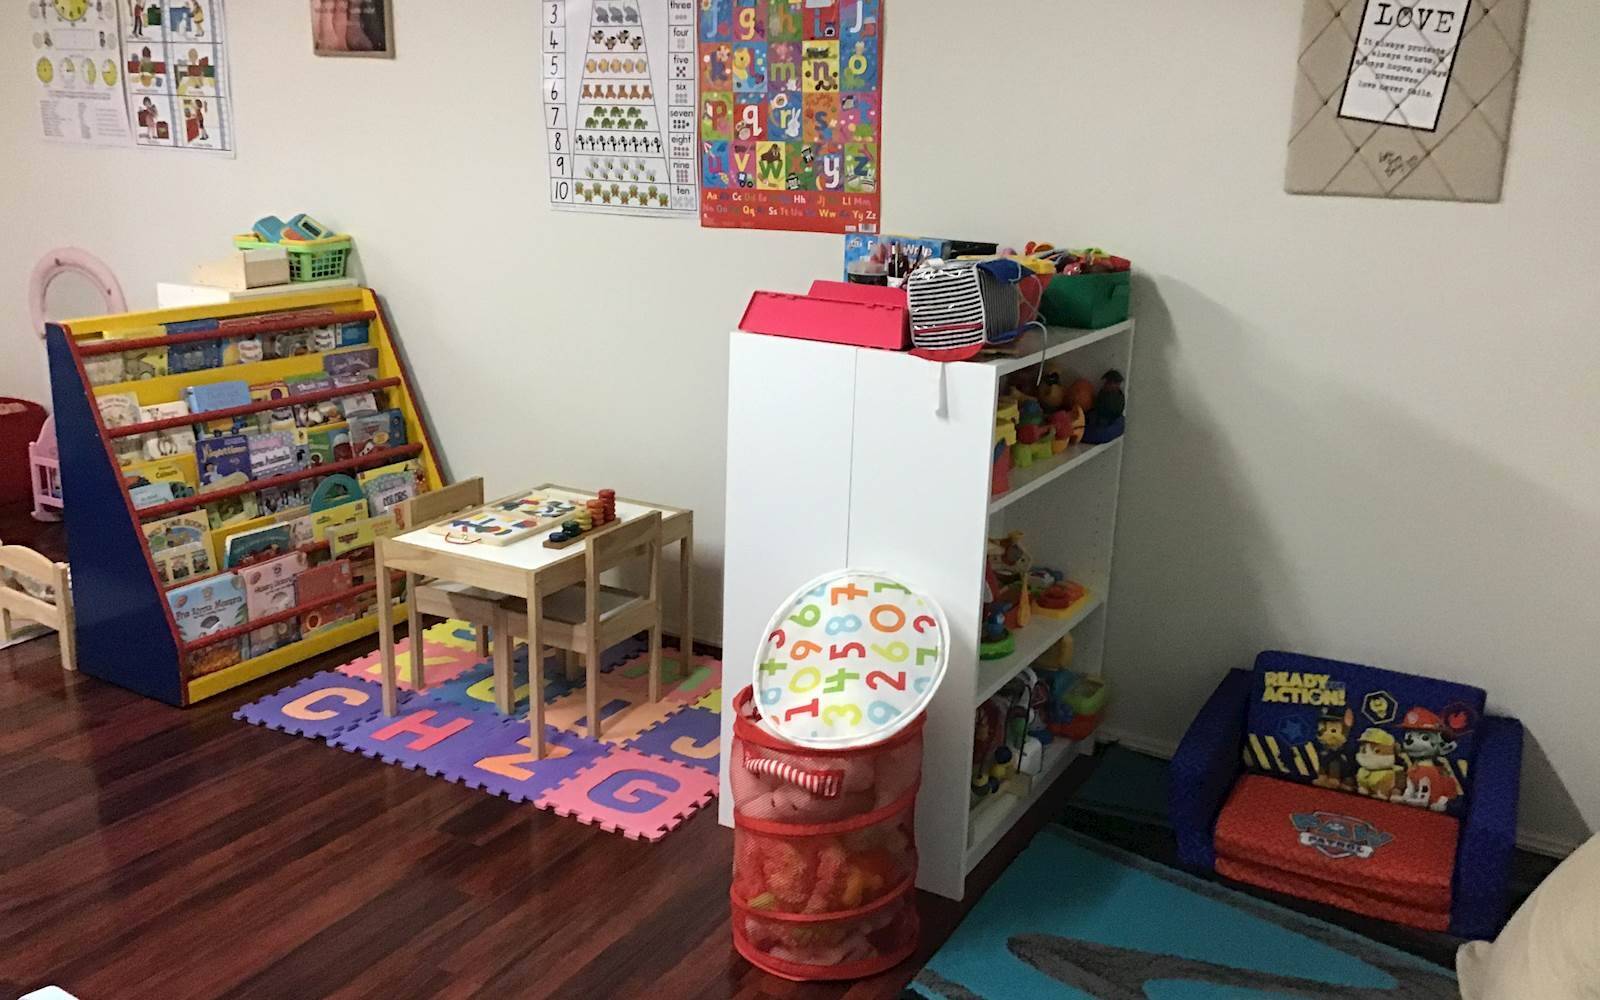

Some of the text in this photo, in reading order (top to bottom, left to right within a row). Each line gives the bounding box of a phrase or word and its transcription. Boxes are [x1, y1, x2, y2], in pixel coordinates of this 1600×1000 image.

[550, 4, 557, 24] 3
[670, 1, 692, 9] three
[739, 7, 755, 40] g
[1373, 3, 1455, 33] LOVE
[550, 30, 558, 49] 4
[673, 28, 689, 37] four
[550, 55, 558, 75] 5
[673, 56, 689, 64] five
[848, 54, 868, 75] o
[770, 62, 796, 82] m
[551, 82, 558, 100] 6
[551, 107, 559, 126] 7
[670, 110, 694, 118] seven
[742, 104, 762, 137] q
[779, 109, 792, 129] r
[555, 132, 561, 151] 8
[671, 135, 691, 145] eight
[556, 156, 564, 175] 9
[734, 153, 749, 172] v
[759, 160, 783, 179] w
[823, 155, 840, 188] y
[555, 181, 569, 200] 10
[676, 187, 690, 195] ten
[706, 192, 718, 200] Aa
[732, 192, 742, 201] Cc
[794, 195, 806, 204] Hh
[842, 195, 851, 205] Ll
[743, 205, 755, 217] Qq
[769, 207, 778, 216] Ss
[819, 209, 836, 218] Ww
[852, 209, 864, 221] Yy
[866, 210, 876, 219] Zz
[825, 614, 862, 636] 8
[829, 642, 866, 660] 5
[823, 668, 860, 694] 4
[866, 671, 906, 691] 2
[1264, 671, 1331, 689] READY
[281, 687, 371, 721] C
[785, 698, 819, 722] 1
[369, 709, 474, 751] H
[587, 768, 681, 813] G
